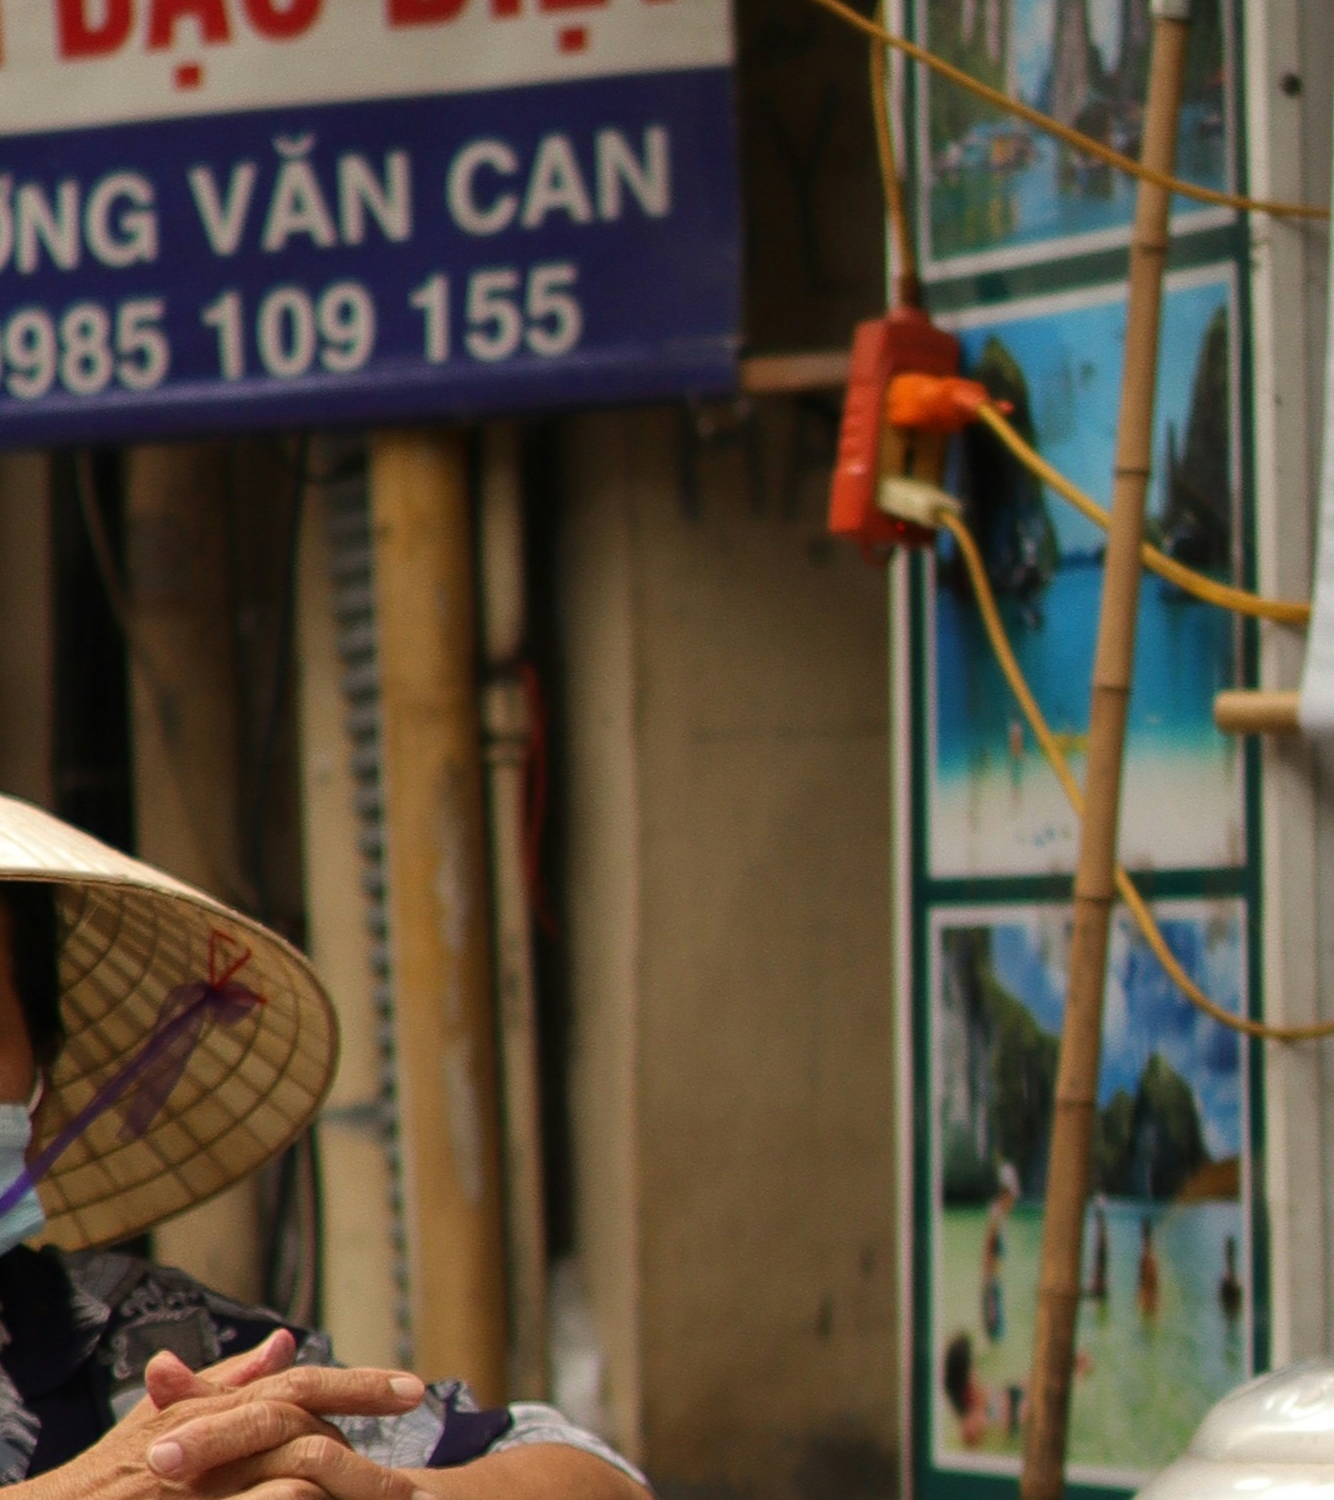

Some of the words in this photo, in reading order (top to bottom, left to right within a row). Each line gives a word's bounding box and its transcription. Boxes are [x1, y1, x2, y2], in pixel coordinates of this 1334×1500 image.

[188, 132, 413, 252] VĂN
[446, 126, 671, 236] CAN
[201, 276, 375, 381] 109
[410, 264, 582, 365] 155
